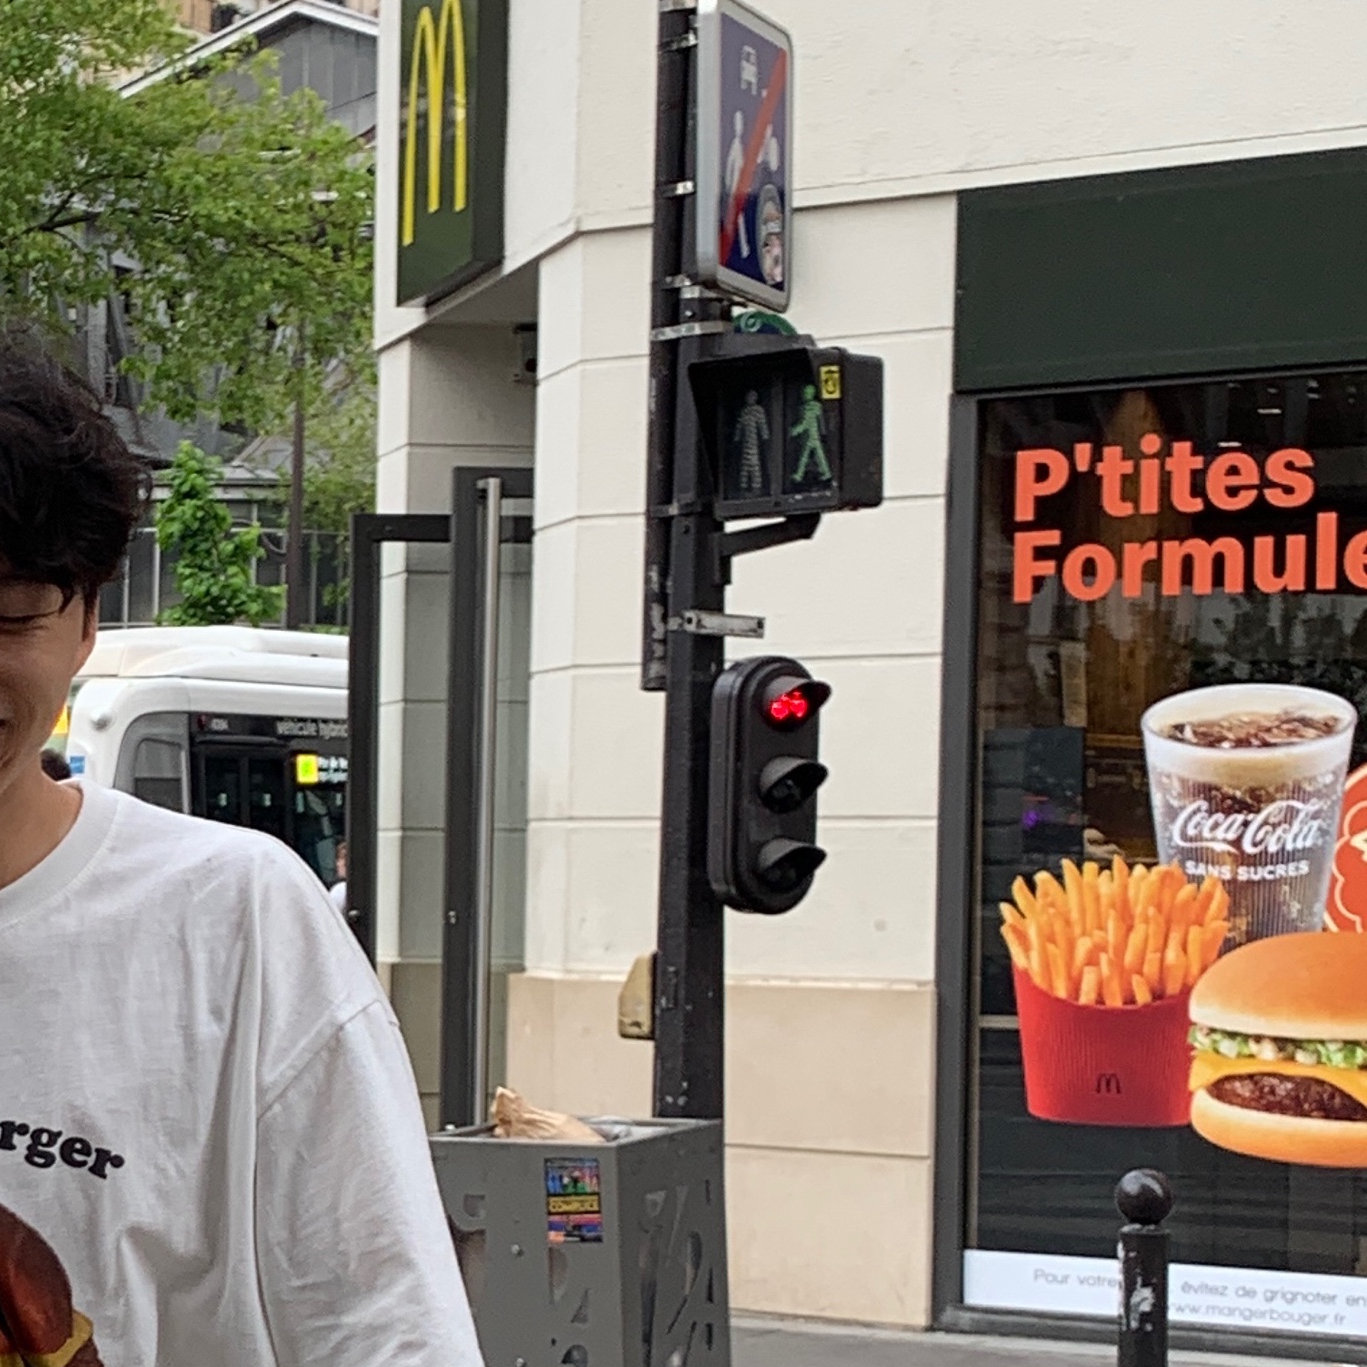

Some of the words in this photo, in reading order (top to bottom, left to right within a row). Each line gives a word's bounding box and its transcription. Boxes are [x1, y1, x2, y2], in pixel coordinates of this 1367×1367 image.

[1014, 433, 1315, 522] P'tites
[1172, 797, 1325, 856] Coca-Cola
[1184, 859, 1232, 881] SANS
[1236, 859, 1310, 881] SUCRES
[1033, 1268, 1070, 1284] Pour
[1076, 1274, 1118, 1288] votre
[1181, 1281, 1229, 1297] évitez
[1234, 1284, 1258, 1299] de
[1263, 1287, 1338, 1305] grignoter
